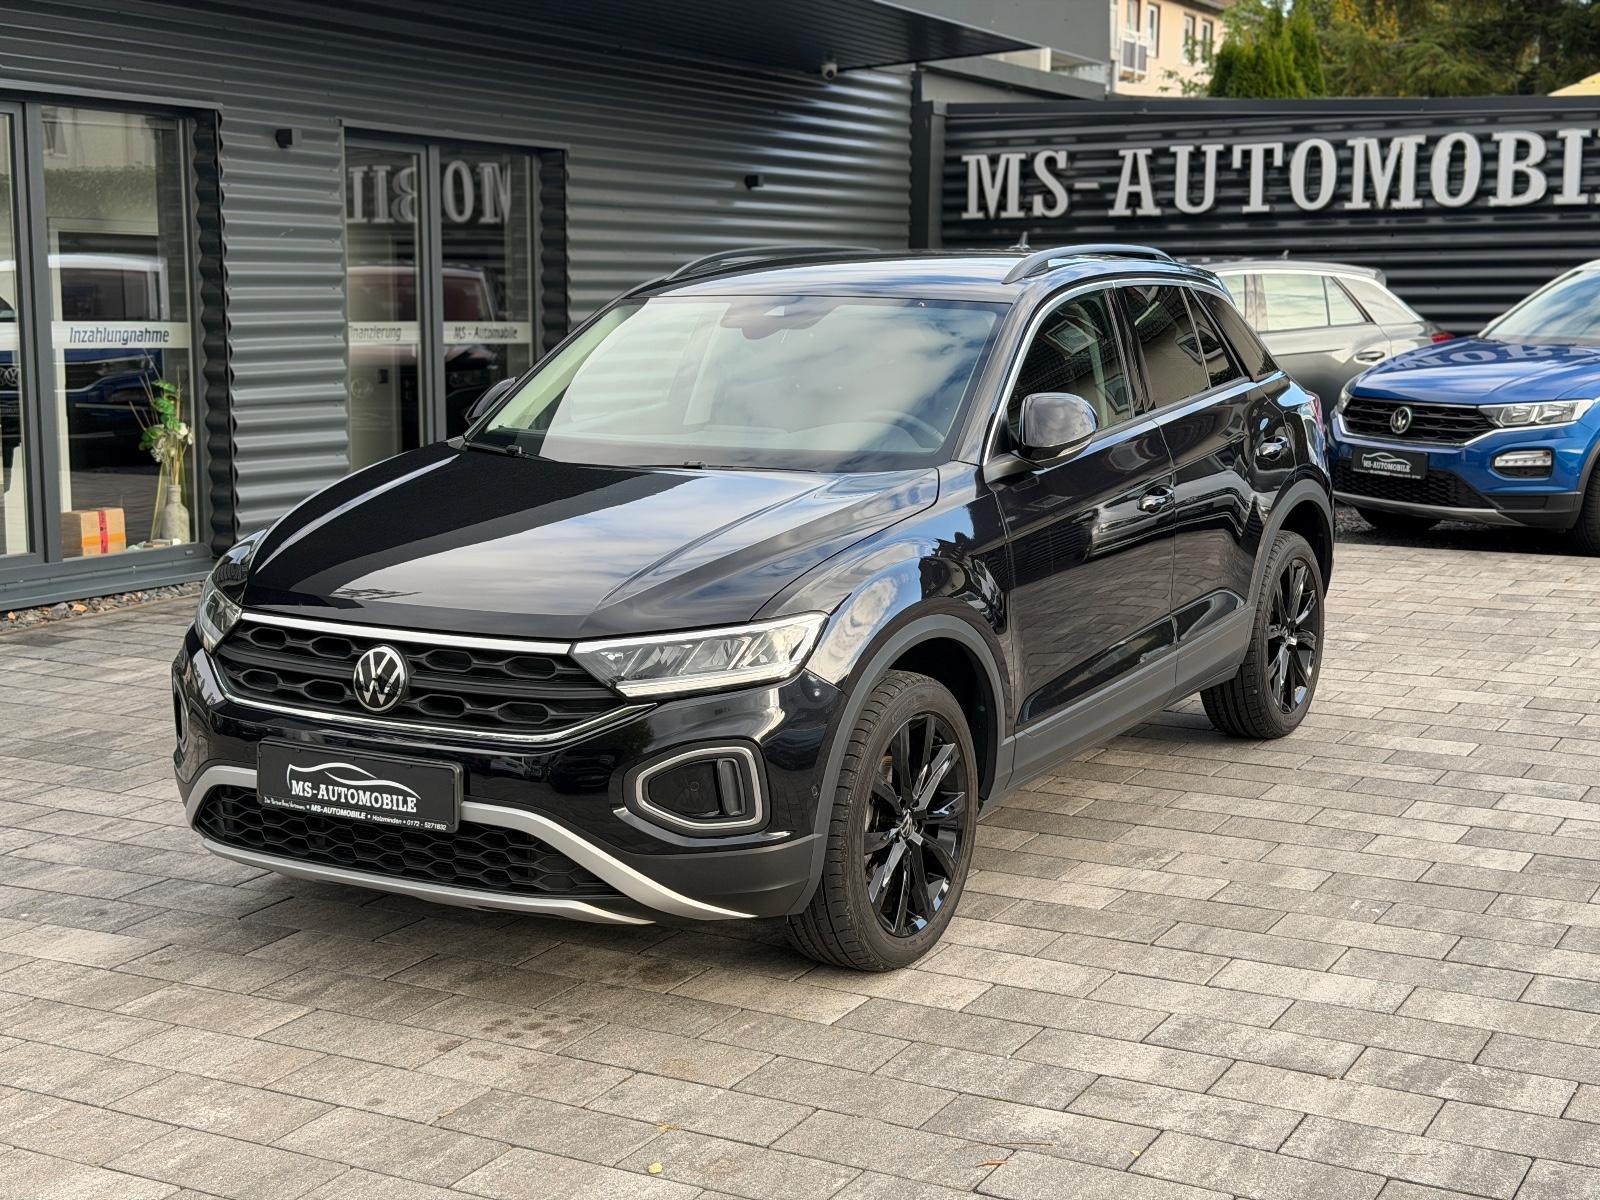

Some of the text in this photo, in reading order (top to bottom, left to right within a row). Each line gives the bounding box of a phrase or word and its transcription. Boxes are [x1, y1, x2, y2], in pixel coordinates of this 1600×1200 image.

[960, 128, 1600, 219] MS-AUTOMOBI
[69, 327, 170, 346] Inzahlungnahme
[349, 325, 402, 342] inanzierung
[474, 326, 518, 340] Automobile
[1363, 460, 1411, 473] MS-AUTOMOBILE
[291, 779, 417, 813] MS-AUTOMOBILE
[311, 804, 366, 820] MS-AUTOMOBILE
[407, 820, 420, 828] 0172
